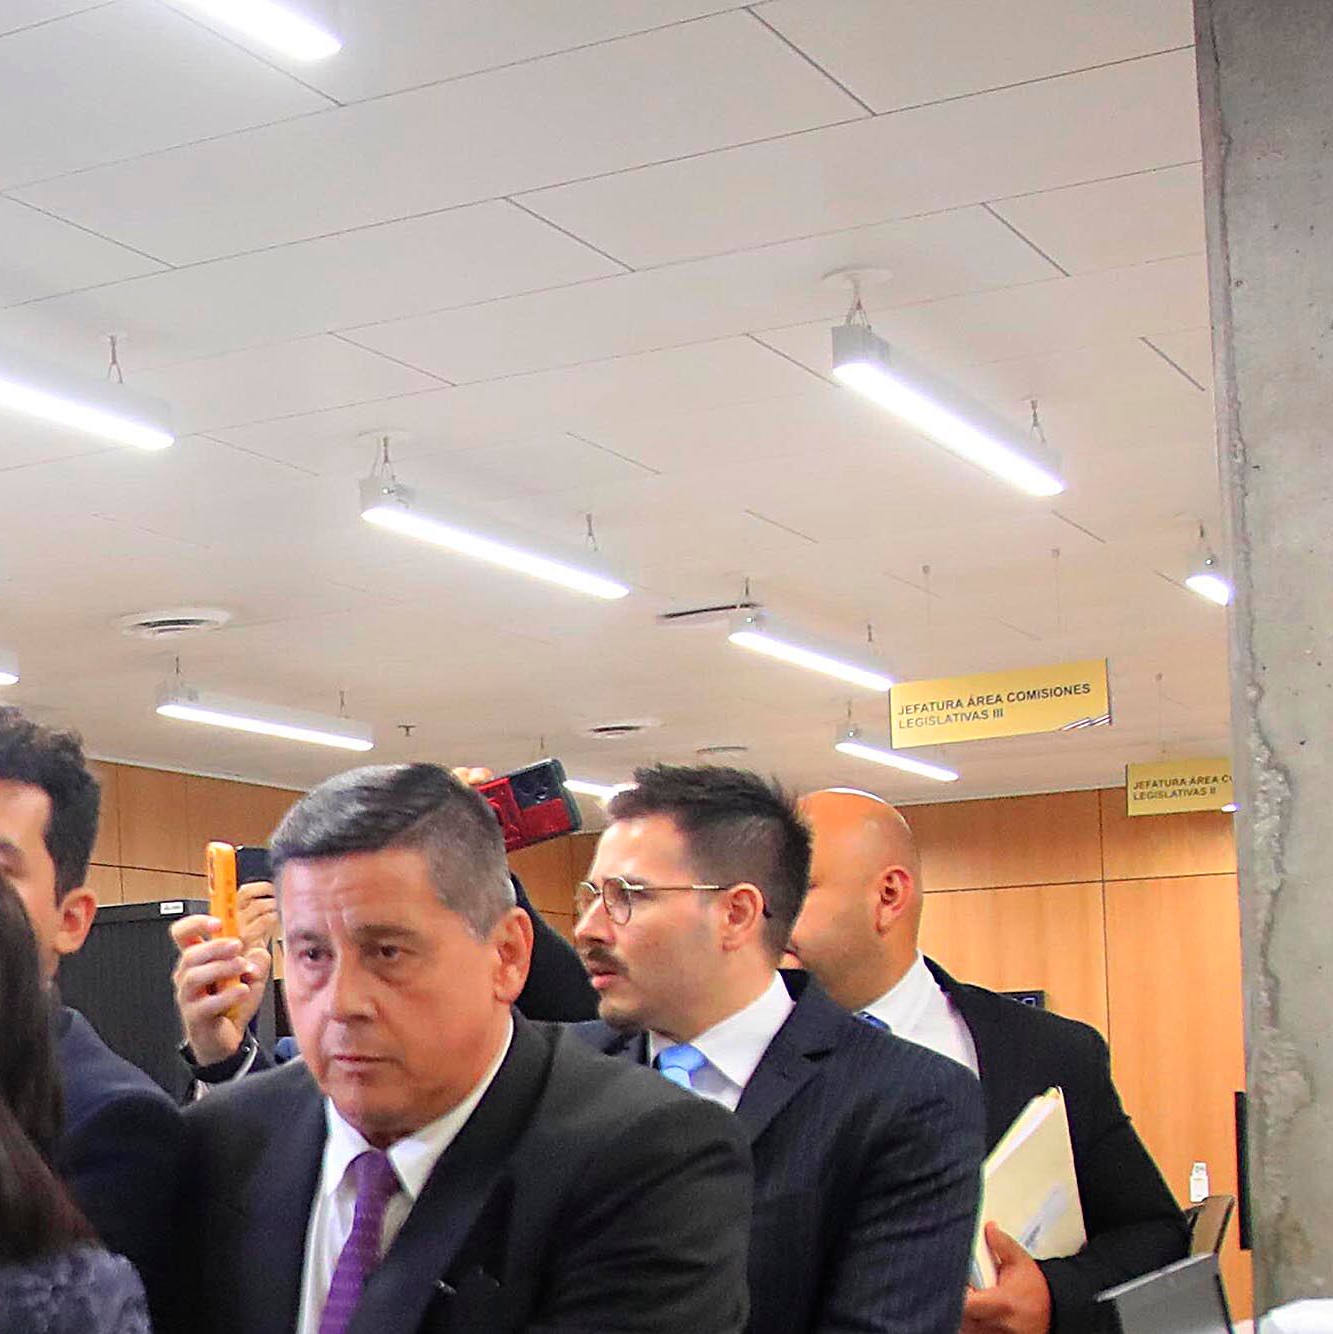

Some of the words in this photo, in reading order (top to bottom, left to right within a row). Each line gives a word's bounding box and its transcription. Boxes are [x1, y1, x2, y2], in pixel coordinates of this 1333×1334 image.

[897, 698, 963, 716] JEFATURA
[967, 691, 1003, 708] ÁREA
[1006, 683, 1092, 703] COMISIONES
[899, 709, 989, 730] LEGISLATIVAS
[993, 708, 1004, 718] III
[1133, 778, 1188, 790] JEFATURA
[1133, 787, 1207, 801] LEGISLATIVAS
